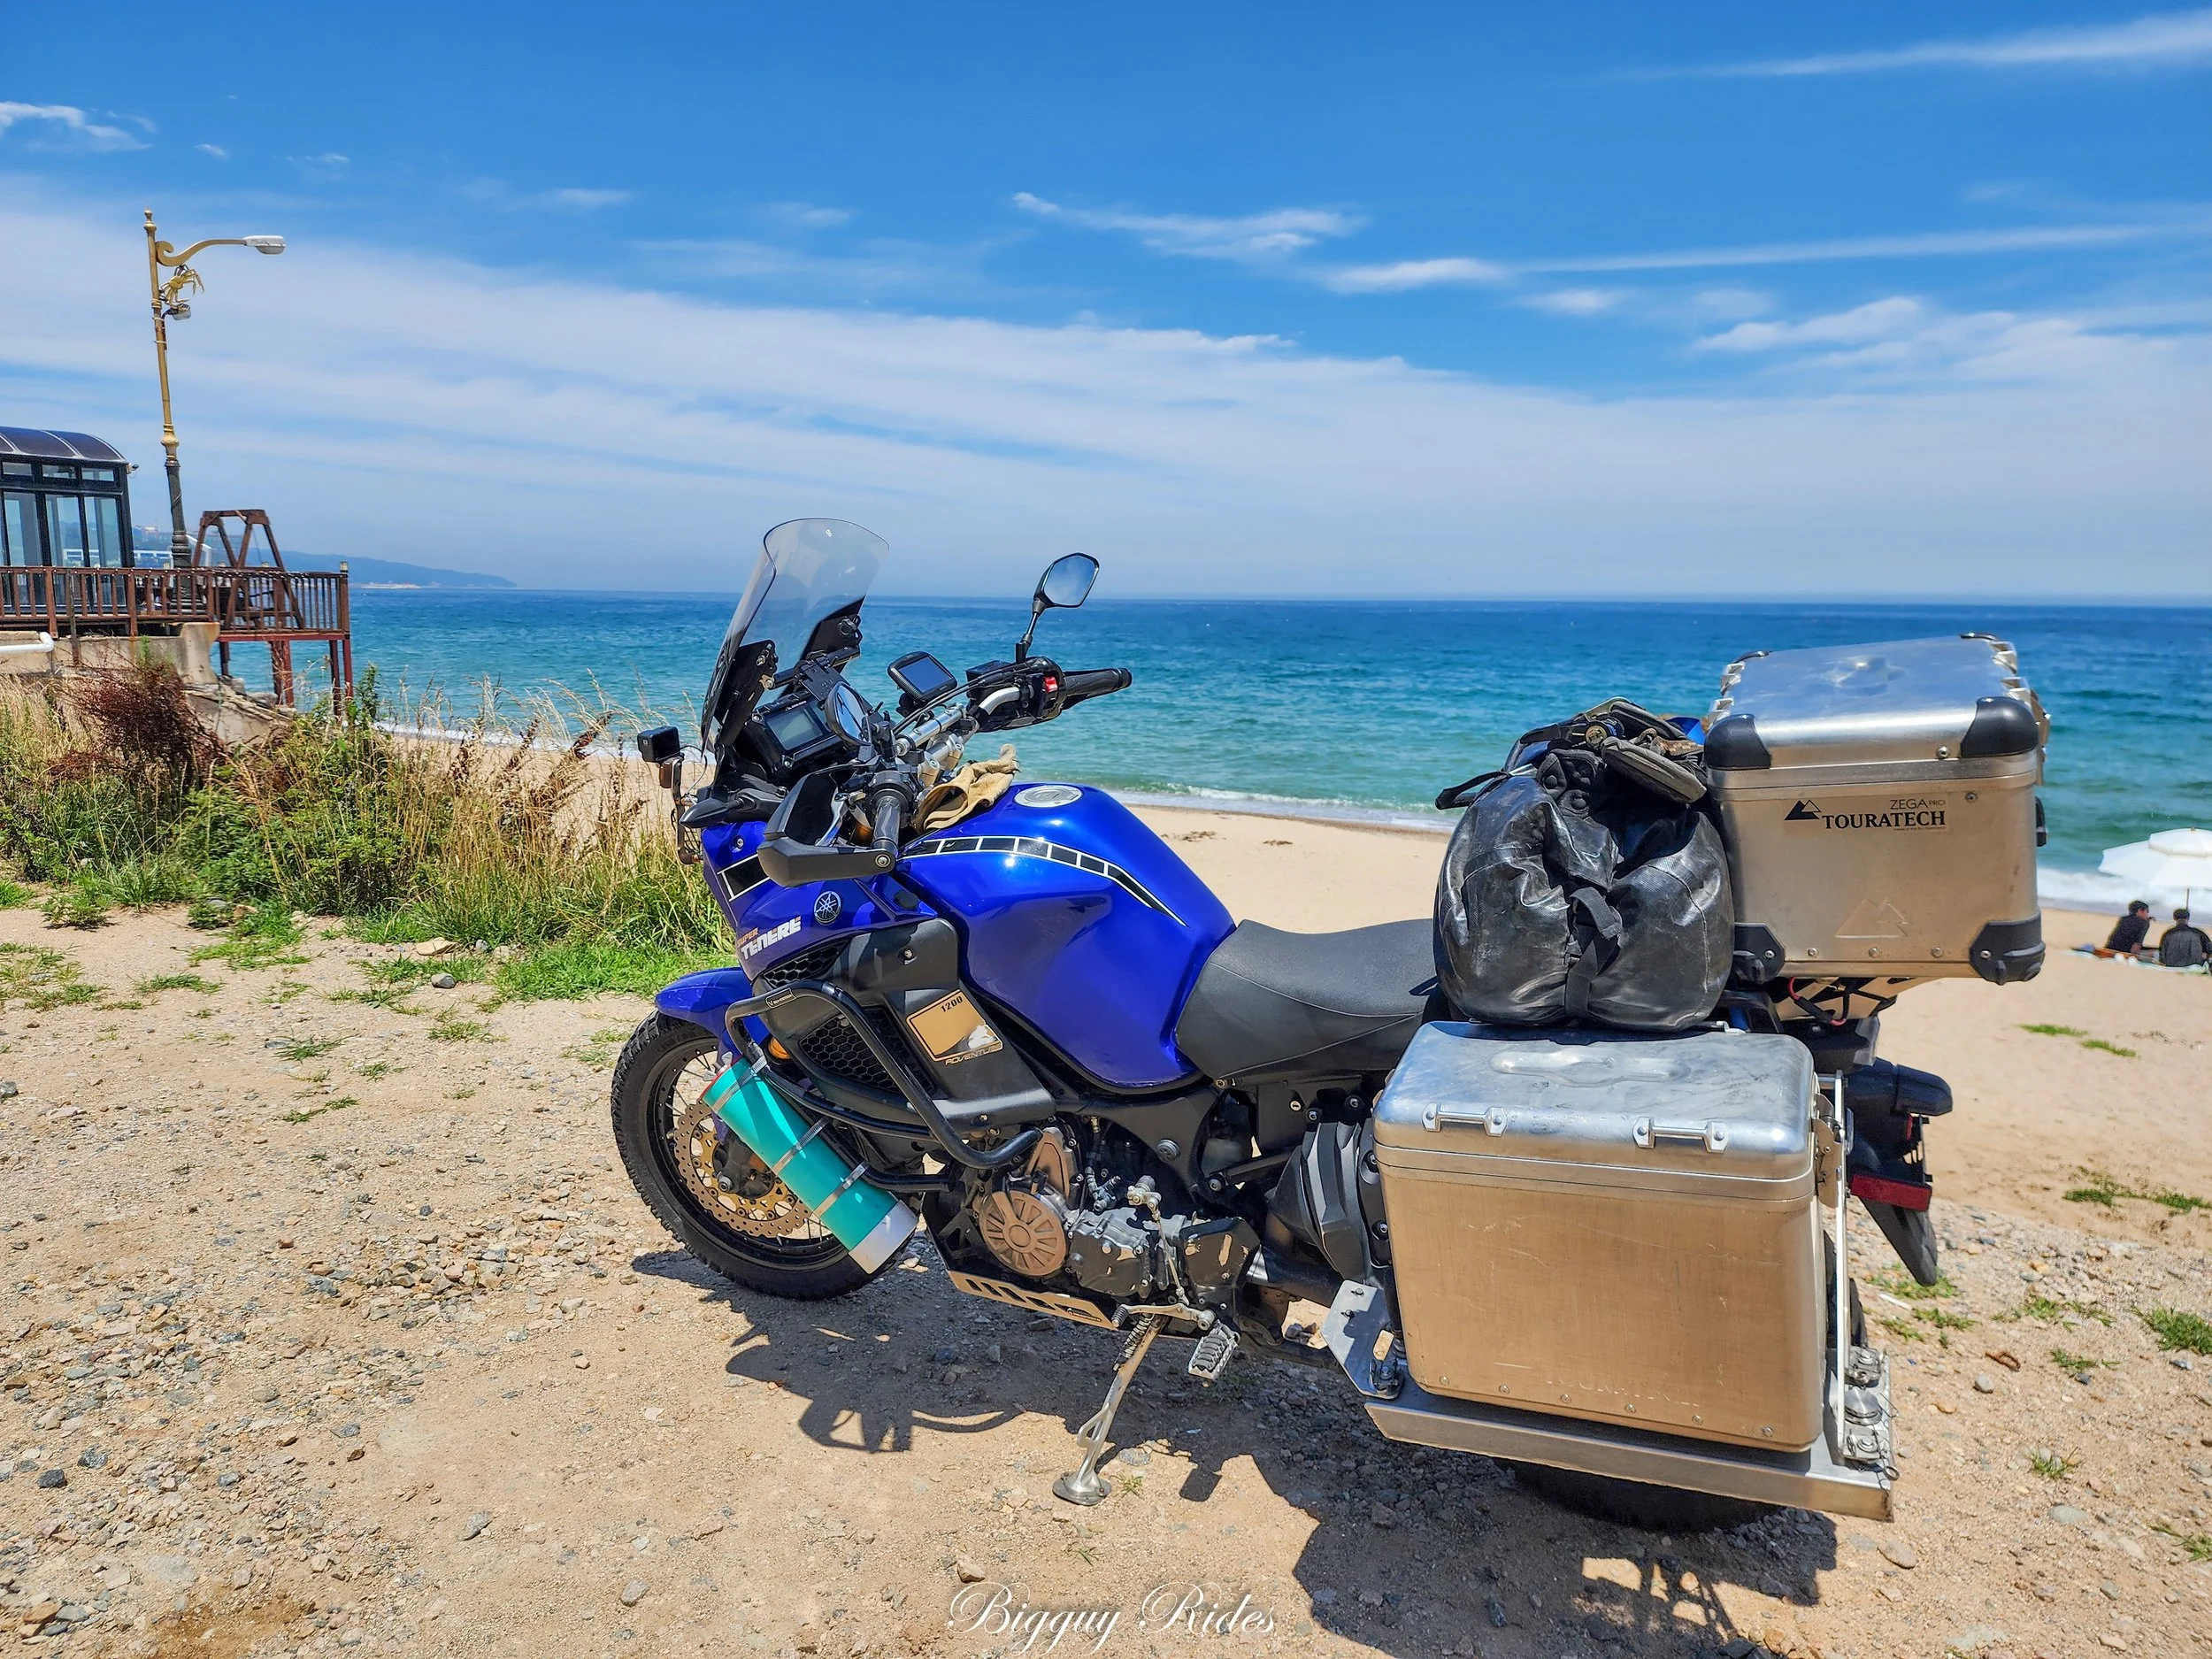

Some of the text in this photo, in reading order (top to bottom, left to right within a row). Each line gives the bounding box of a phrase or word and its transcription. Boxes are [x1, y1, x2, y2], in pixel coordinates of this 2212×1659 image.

[1890, 798, 1929, 810] ZEGA
[1822, 810, 1946, 829] TOURATECH
[941, 995, 964, 1012] 1200
